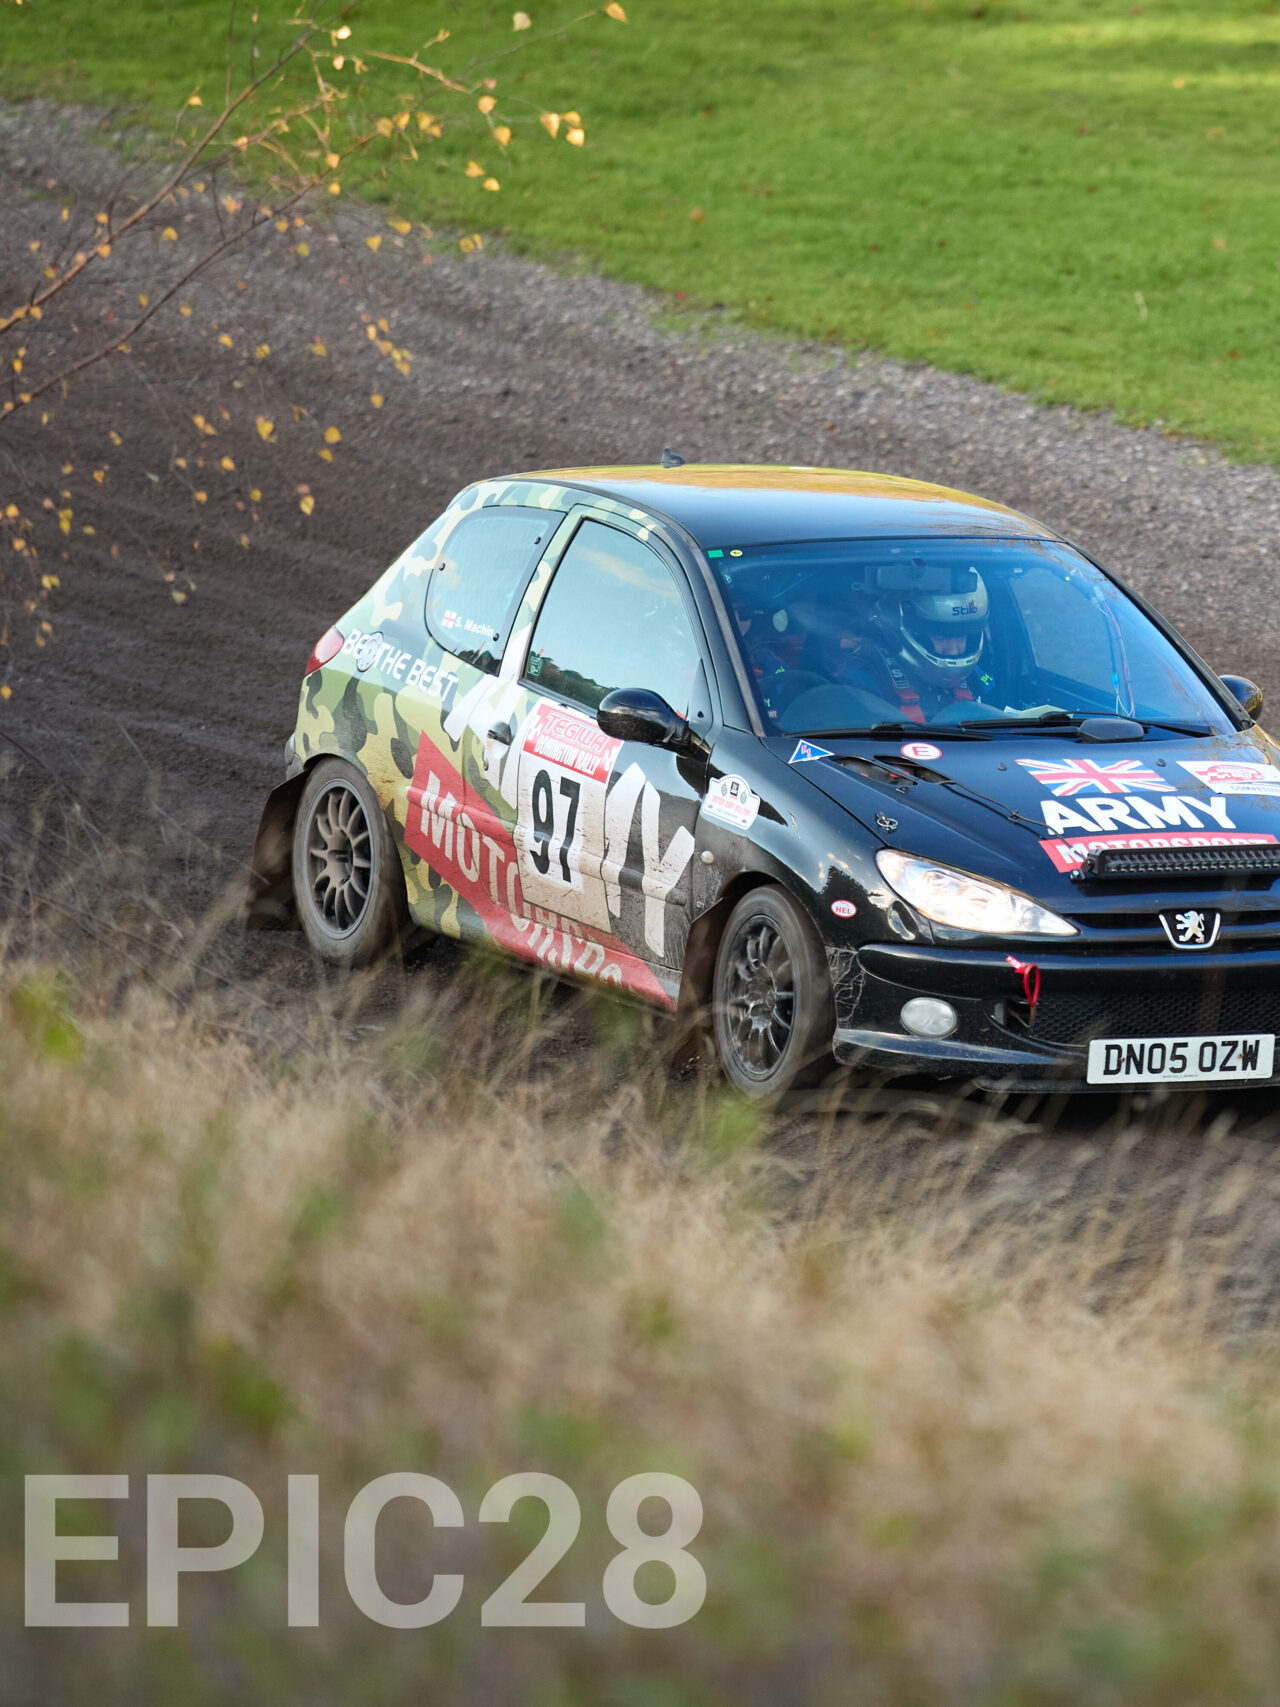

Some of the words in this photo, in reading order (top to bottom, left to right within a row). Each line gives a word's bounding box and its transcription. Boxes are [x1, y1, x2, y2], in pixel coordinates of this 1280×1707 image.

[464, 619, 495, 637] Machin
[373, 641, 412, 680] THE
[405, 658, 459, 702] BEST
[544, 712, 610, 753] TEGIWA
[911, 745, 933, 757] E
[574, 750, 601, 775] RALLY
[529, 769, 581, 883] 97
[1040, 795, 1236, 835] ARMY
[420, 770, 636, 989] MOTORSPO
[836, 906, 851, 914] HEL
[1103, 1042, 1188, 1075] DN05
[1198, 1039, 1260, 1072] OZW
